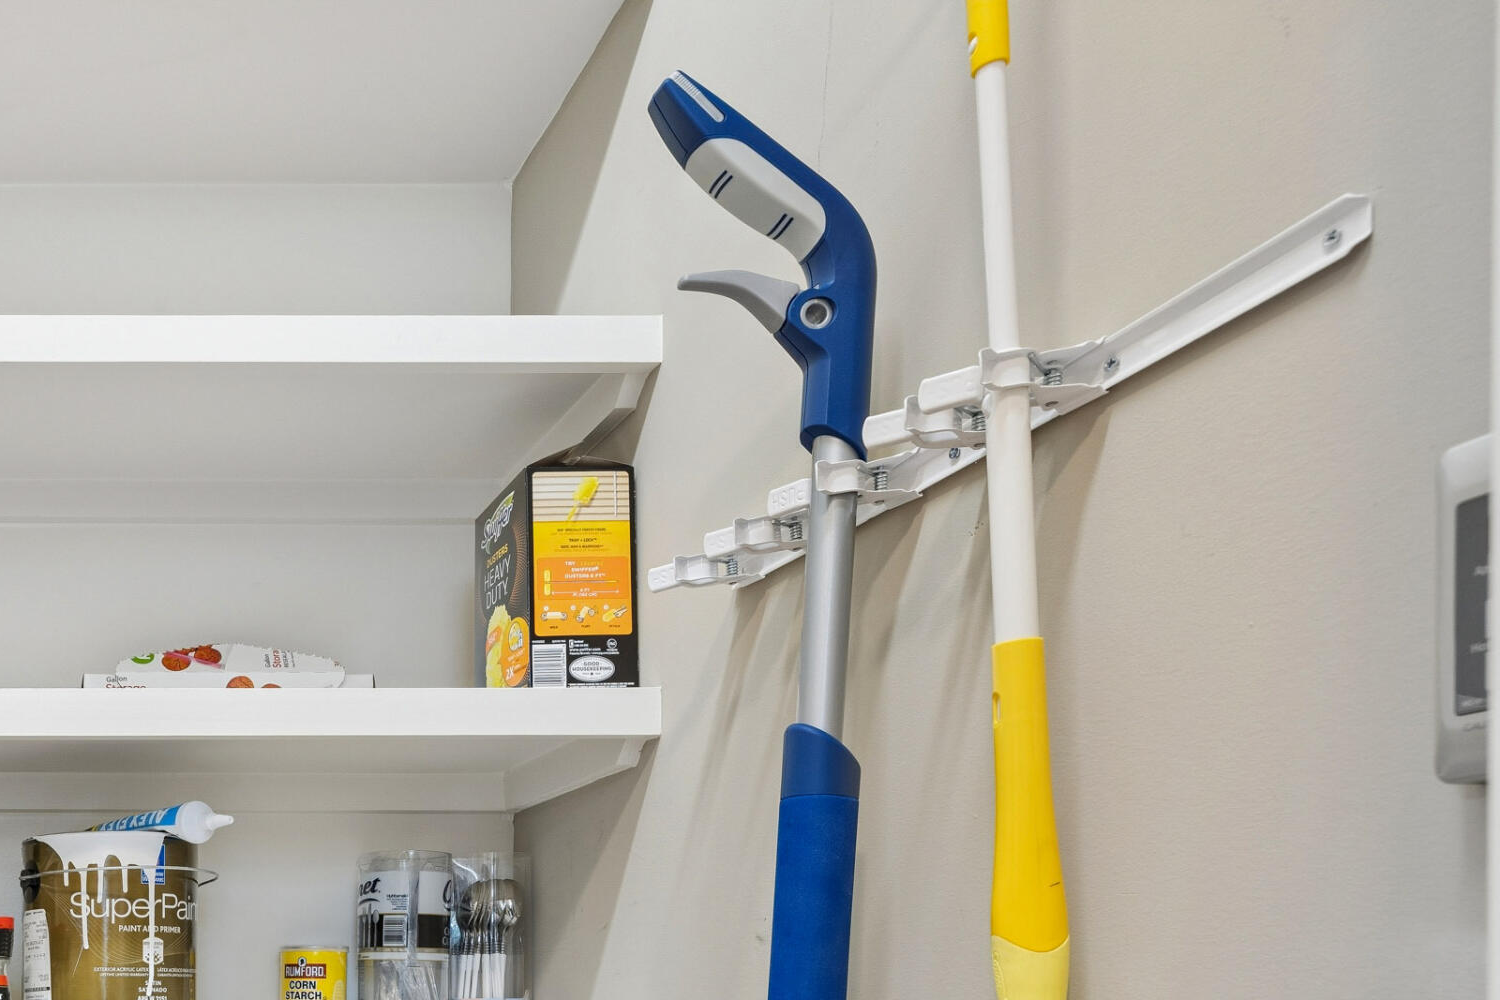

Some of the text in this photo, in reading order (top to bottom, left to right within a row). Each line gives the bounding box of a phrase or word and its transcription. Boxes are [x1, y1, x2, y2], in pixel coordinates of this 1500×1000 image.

[484, 554, 512, 592] HEAVY
[485, 576, 509, 610] DUTY
[118, 924, 142, 932] PAINT
[160, 925, 181, 934] PRIMER
[285, 966, 324, 977] RUMFORD
[289, 980, 316, 990] CORN
[285, 991, 322, 1000] STARCH
